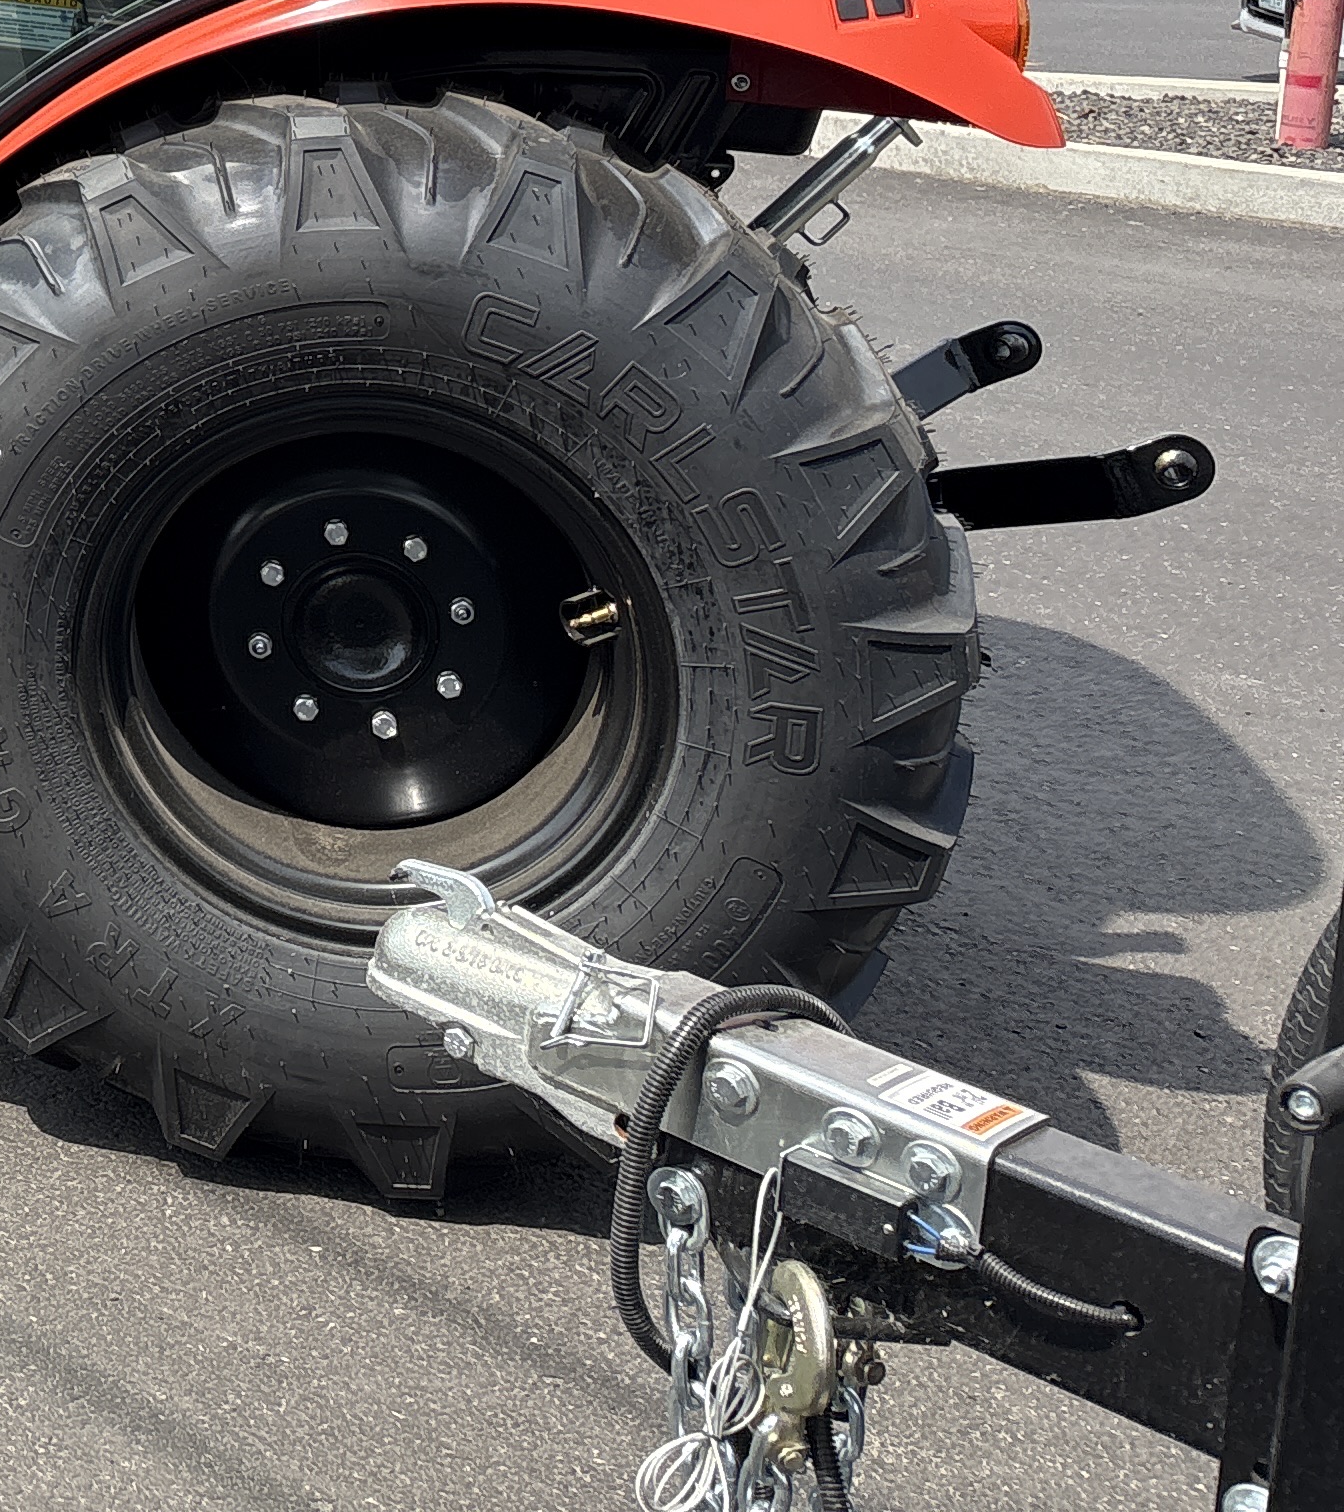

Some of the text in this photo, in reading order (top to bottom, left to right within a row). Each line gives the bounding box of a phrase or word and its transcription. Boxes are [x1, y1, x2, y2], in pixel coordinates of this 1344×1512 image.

[7, 276, 293, 456] TRACTION DRIVE WHEEL SERVICE
[461, 291, 826, 776] CARLSTAR
[39, 869, 244, 1046] XTRA
